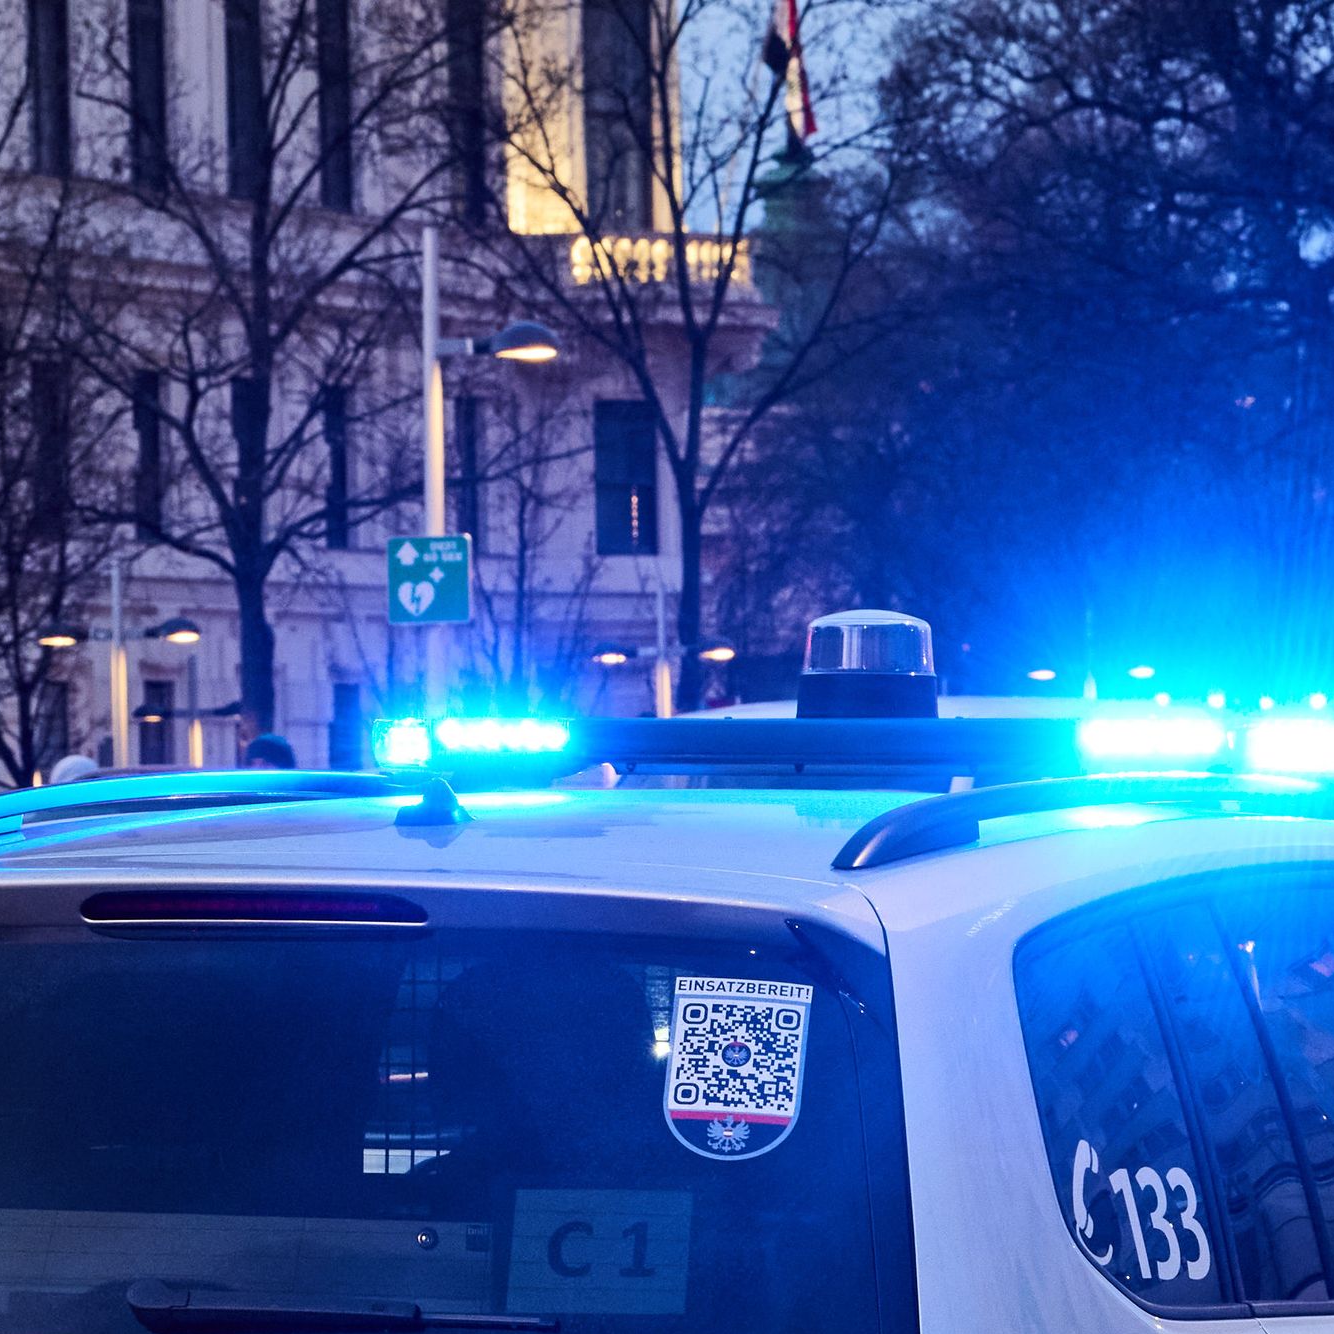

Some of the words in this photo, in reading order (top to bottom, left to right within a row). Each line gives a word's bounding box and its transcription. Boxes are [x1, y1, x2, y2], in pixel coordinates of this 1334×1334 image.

[678, 979, 810, 999] EINSATZBEREIT!
[547, 1221, 594, 1278] C
[619, 1221, 655, 1278] 1
[1109, 1166, 1211, 1280] 133
